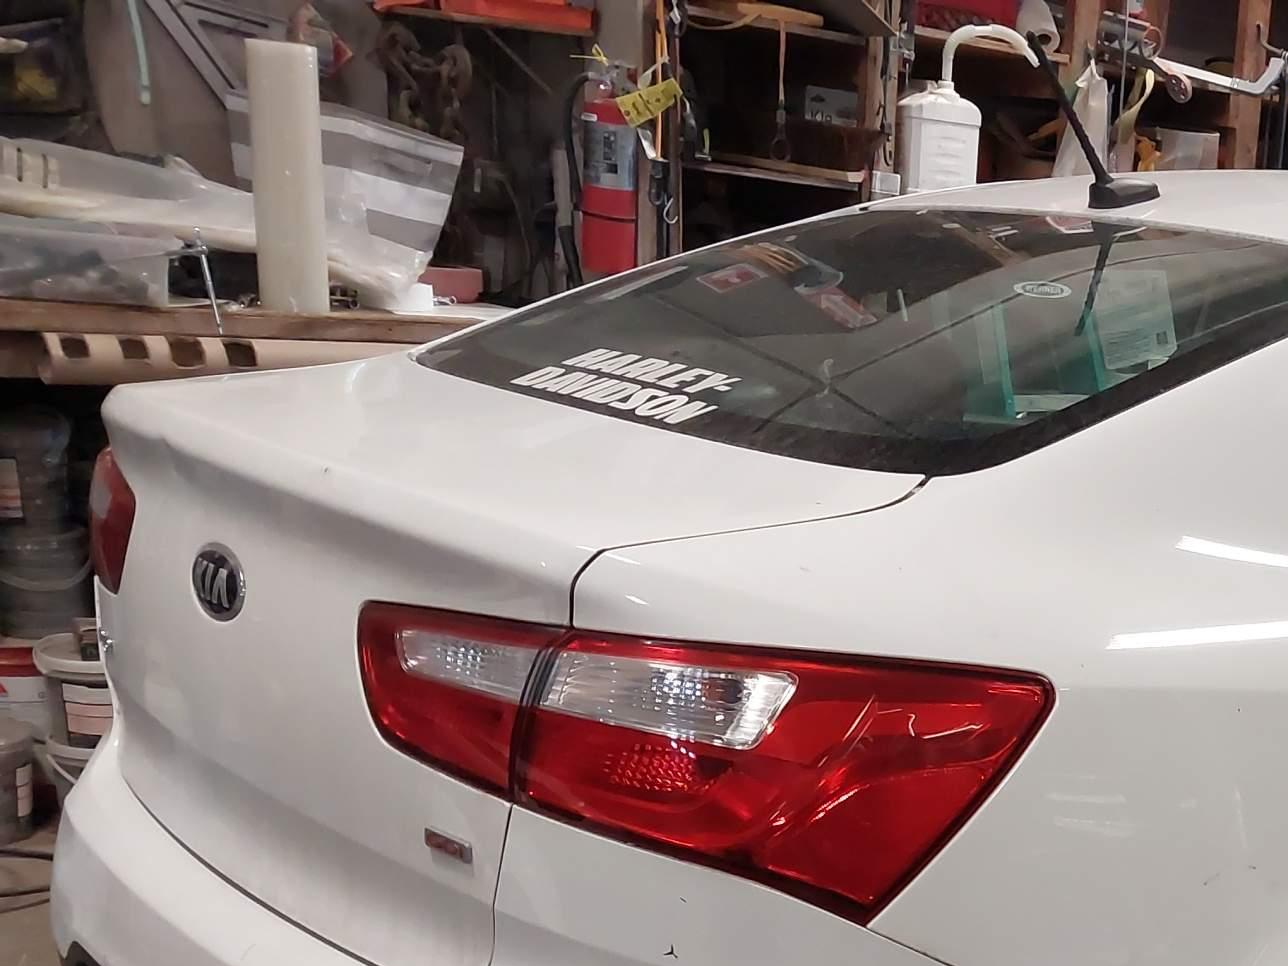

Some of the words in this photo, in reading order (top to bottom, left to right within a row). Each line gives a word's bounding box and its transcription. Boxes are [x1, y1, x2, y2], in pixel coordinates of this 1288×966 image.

[509, 366, 719, 424] DAVIDSON
[561, 348, 742, 393] HARLEY-
[195, 557, 229, 608] KIA
